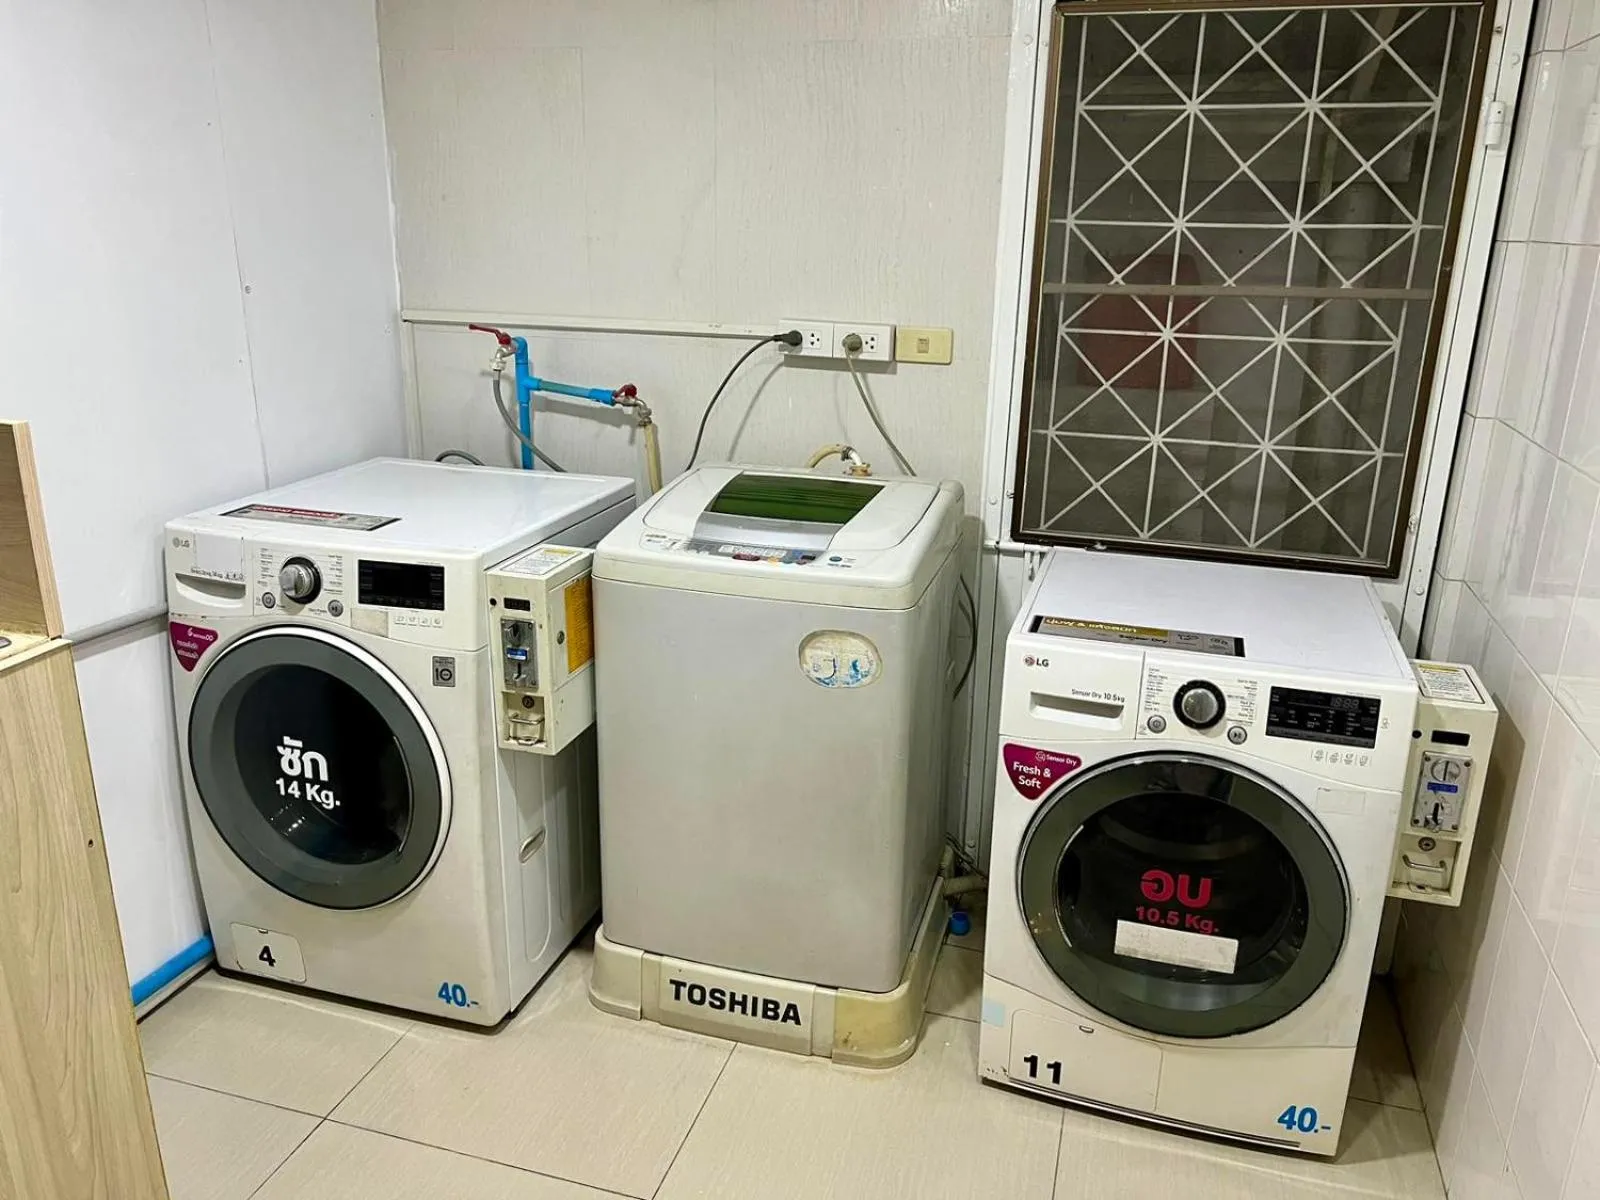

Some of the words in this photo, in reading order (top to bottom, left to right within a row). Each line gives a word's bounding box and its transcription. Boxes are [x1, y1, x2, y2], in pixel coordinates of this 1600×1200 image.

[1036, 658, 1049, 667] LG
[276, 735, 329, 782] ซัก
[1012, 761, 1041, 776] Fresh
[1043, 767, 1051, 778] &
[1046, 754, 1065, 763] Sensor
[1065, 758, 1077, 767] Dry
[275, 777, 301, 799] 14
[305, 782, 341, 810] Kg.
[1018, 775, 1041, 789] Soft
[1140, 869, 1213, 908] อบ
[1136, 905, 1180, 926] 10.5
[1185, 913, 1219, 935] Kg.
[258, 945, 276, 968] 4
[437, 981, 480, 1008] 40.-
[669, 978, 802, 1027] TOSHIBA
[1023, 1054, 1062, 1085] 11
[1277, 1105, 1332, 1134] 40.-
